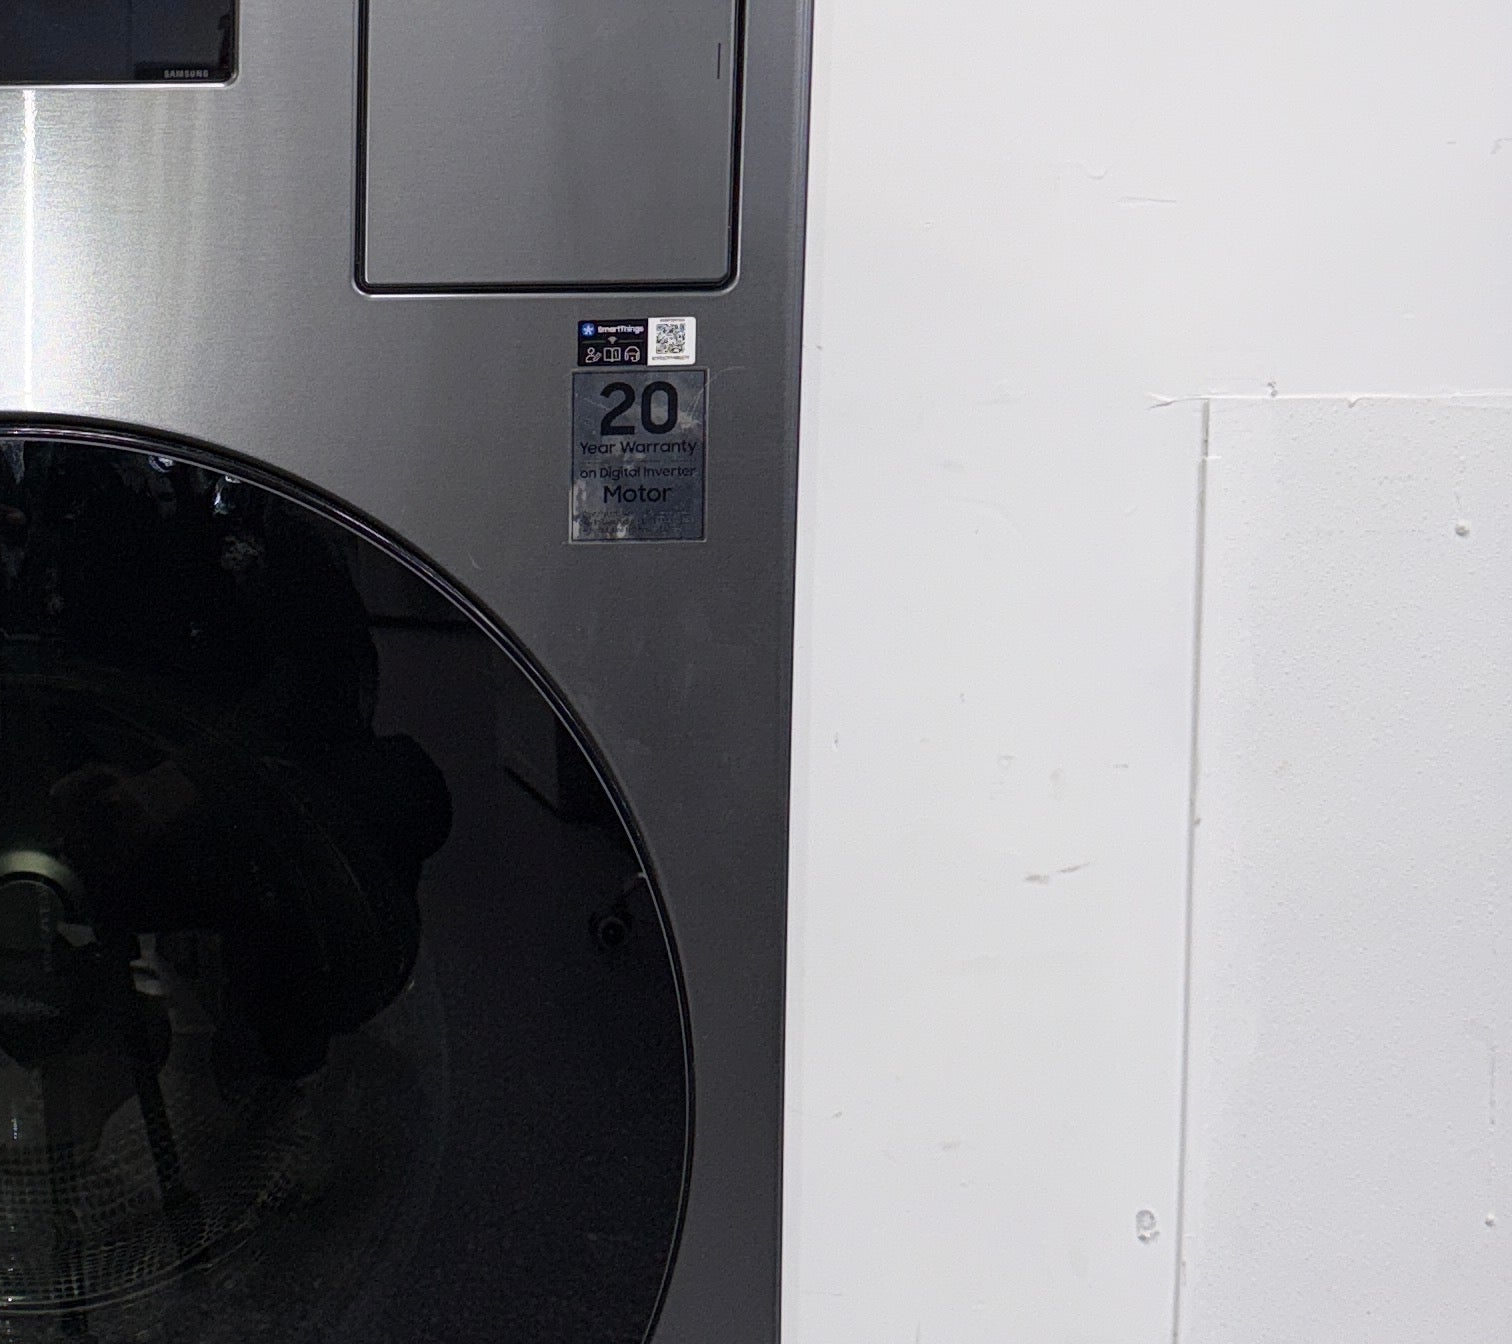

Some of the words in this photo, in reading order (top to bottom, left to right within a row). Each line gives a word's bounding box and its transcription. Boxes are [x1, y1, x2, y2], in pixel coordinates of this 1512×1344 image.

[164, 69, 209, 78] SAMSUNG
[597, 325, 645, 334] SmartThings
[600, 381, 678, 436] 20
[580, 442, 616, 455] Year
[620, 440, 697, 455] Warranty
[580, 470, 596, 478] on
[600, 466, 640, 481] Digital
[643, 466, 696, 476] Inverter
[603, 485, 672, 503] Motor
